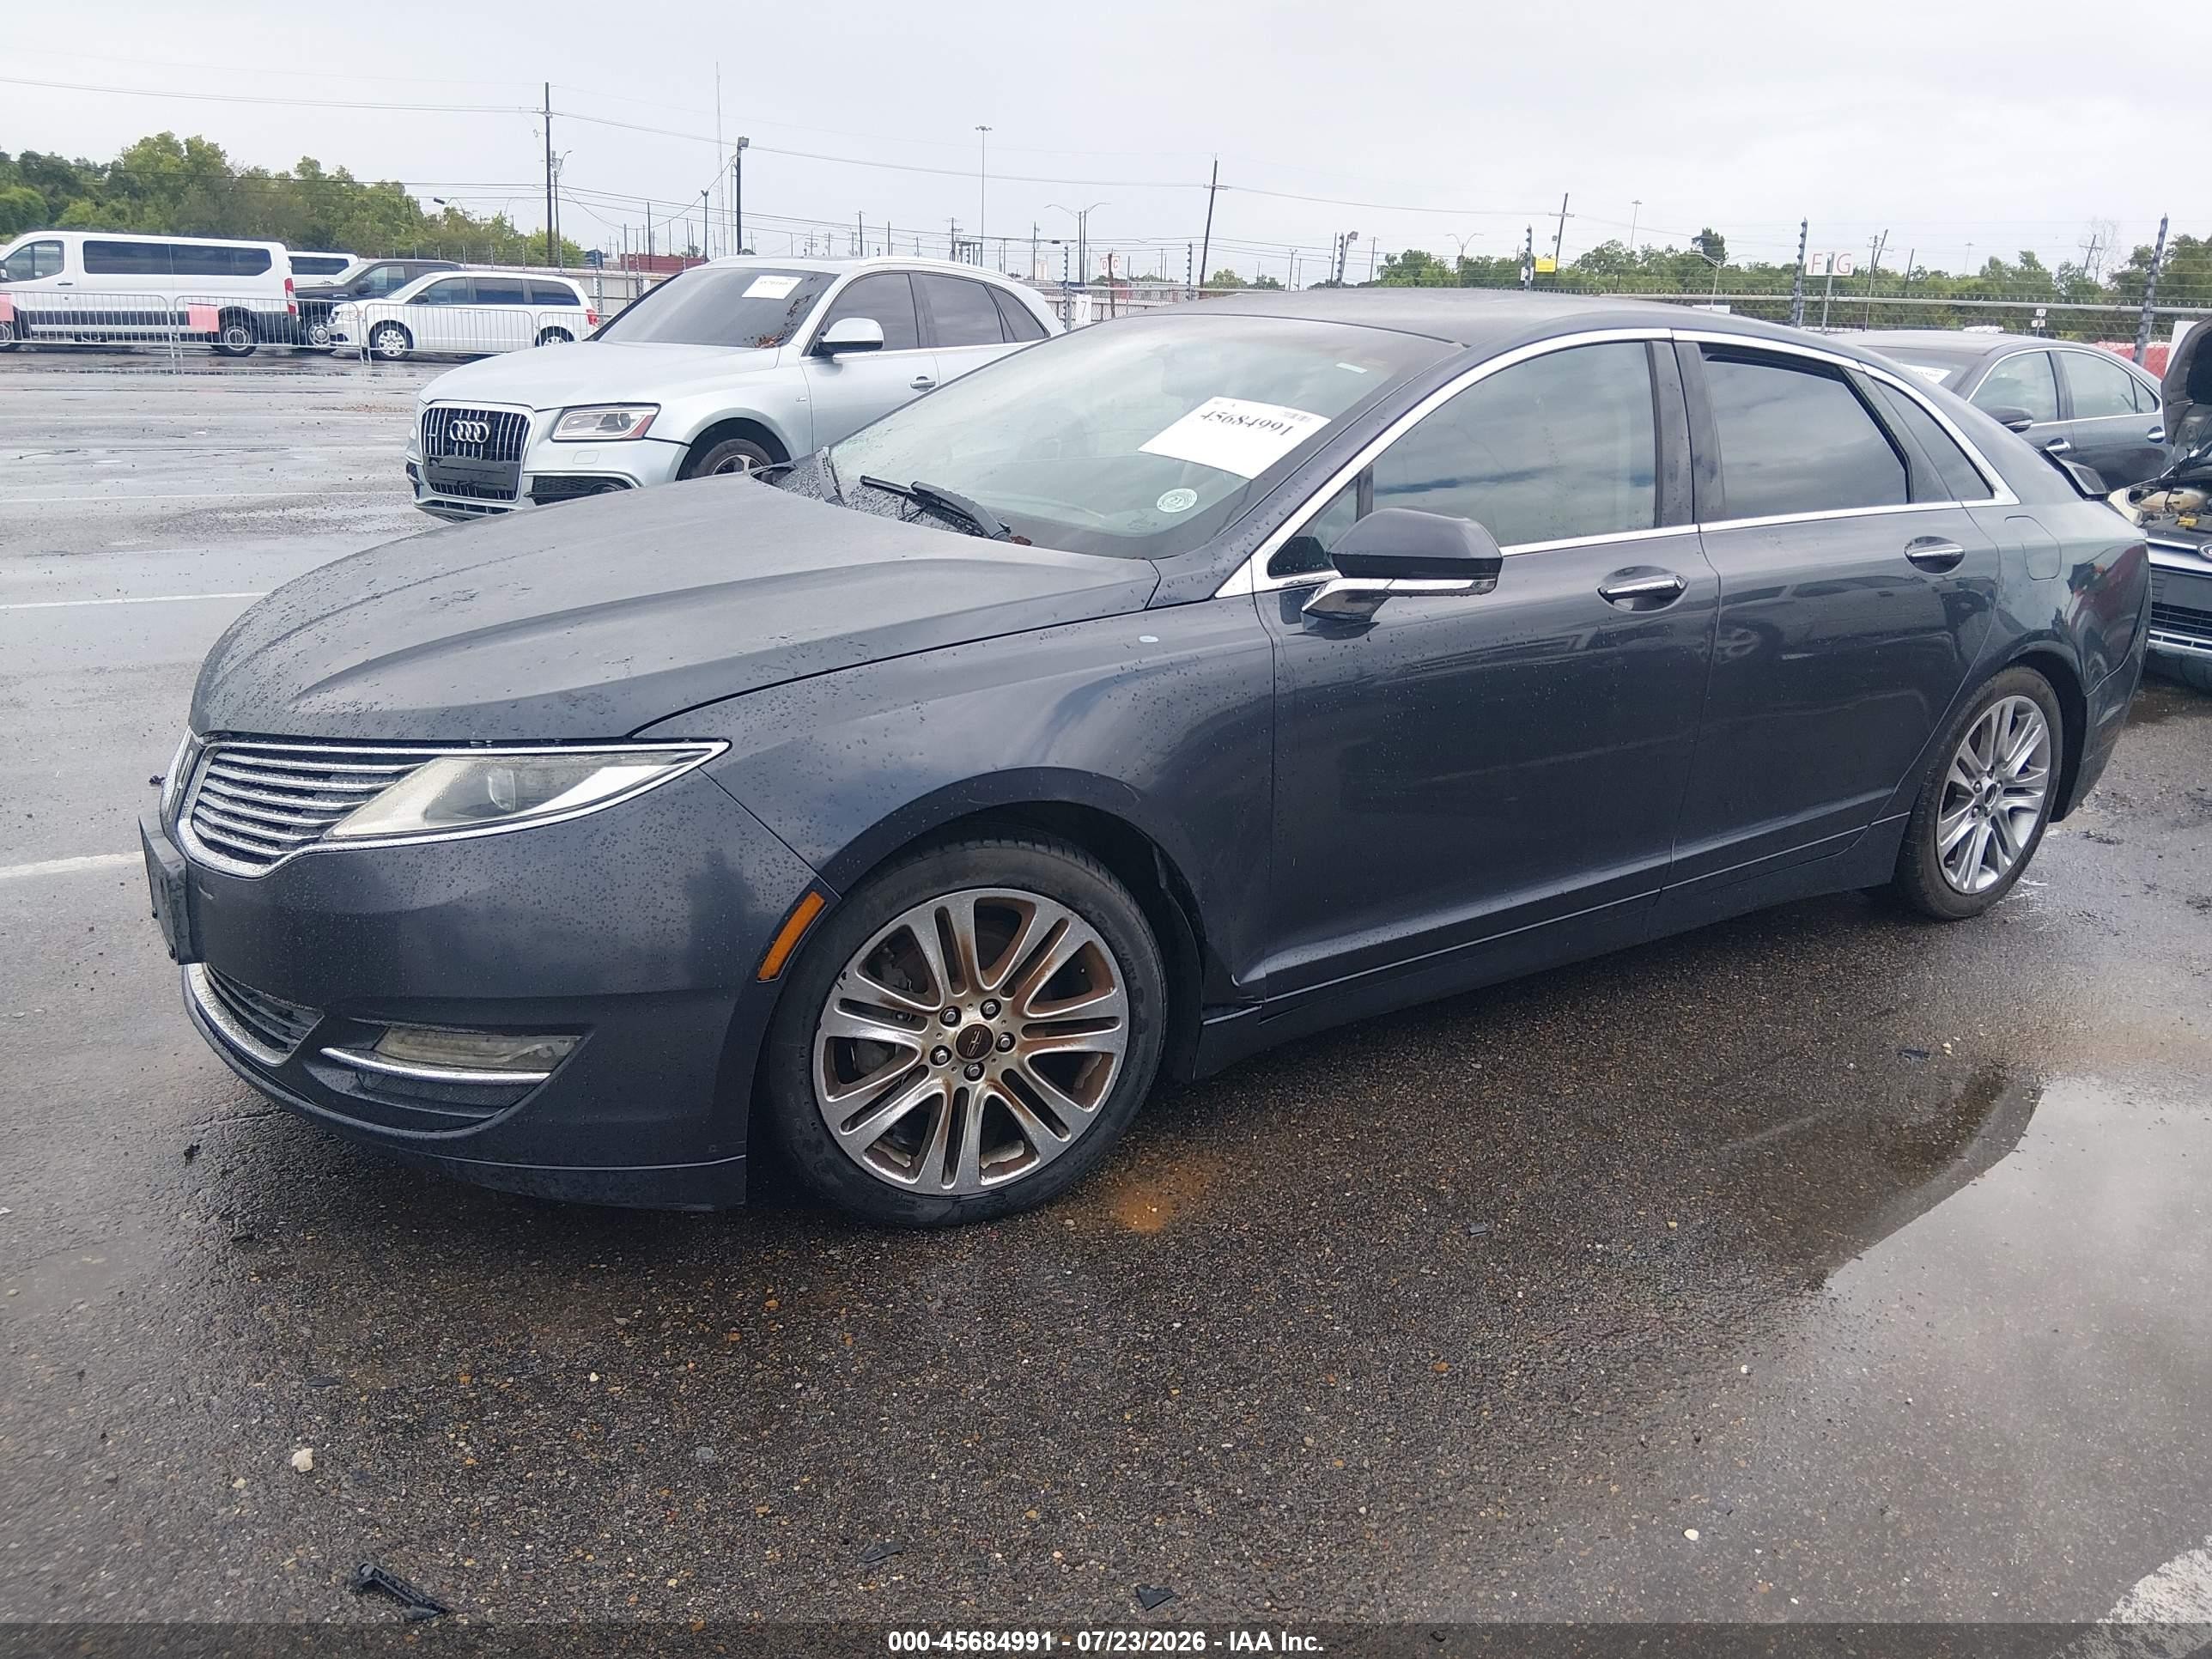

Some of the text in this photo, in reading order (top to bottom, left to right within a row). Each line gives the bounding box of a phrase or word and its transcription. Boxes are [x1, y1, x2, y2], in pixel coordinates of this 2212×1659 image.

[1102, 260, 1108, 270] D
[1113, 259, 1119, 269] C
[1811, 252, 1822, 274] F
[1837, 252, 1851, 274] G
[1080, 301, 1087, 319] 7
[1200, 410, 1295, 436] 45684991
